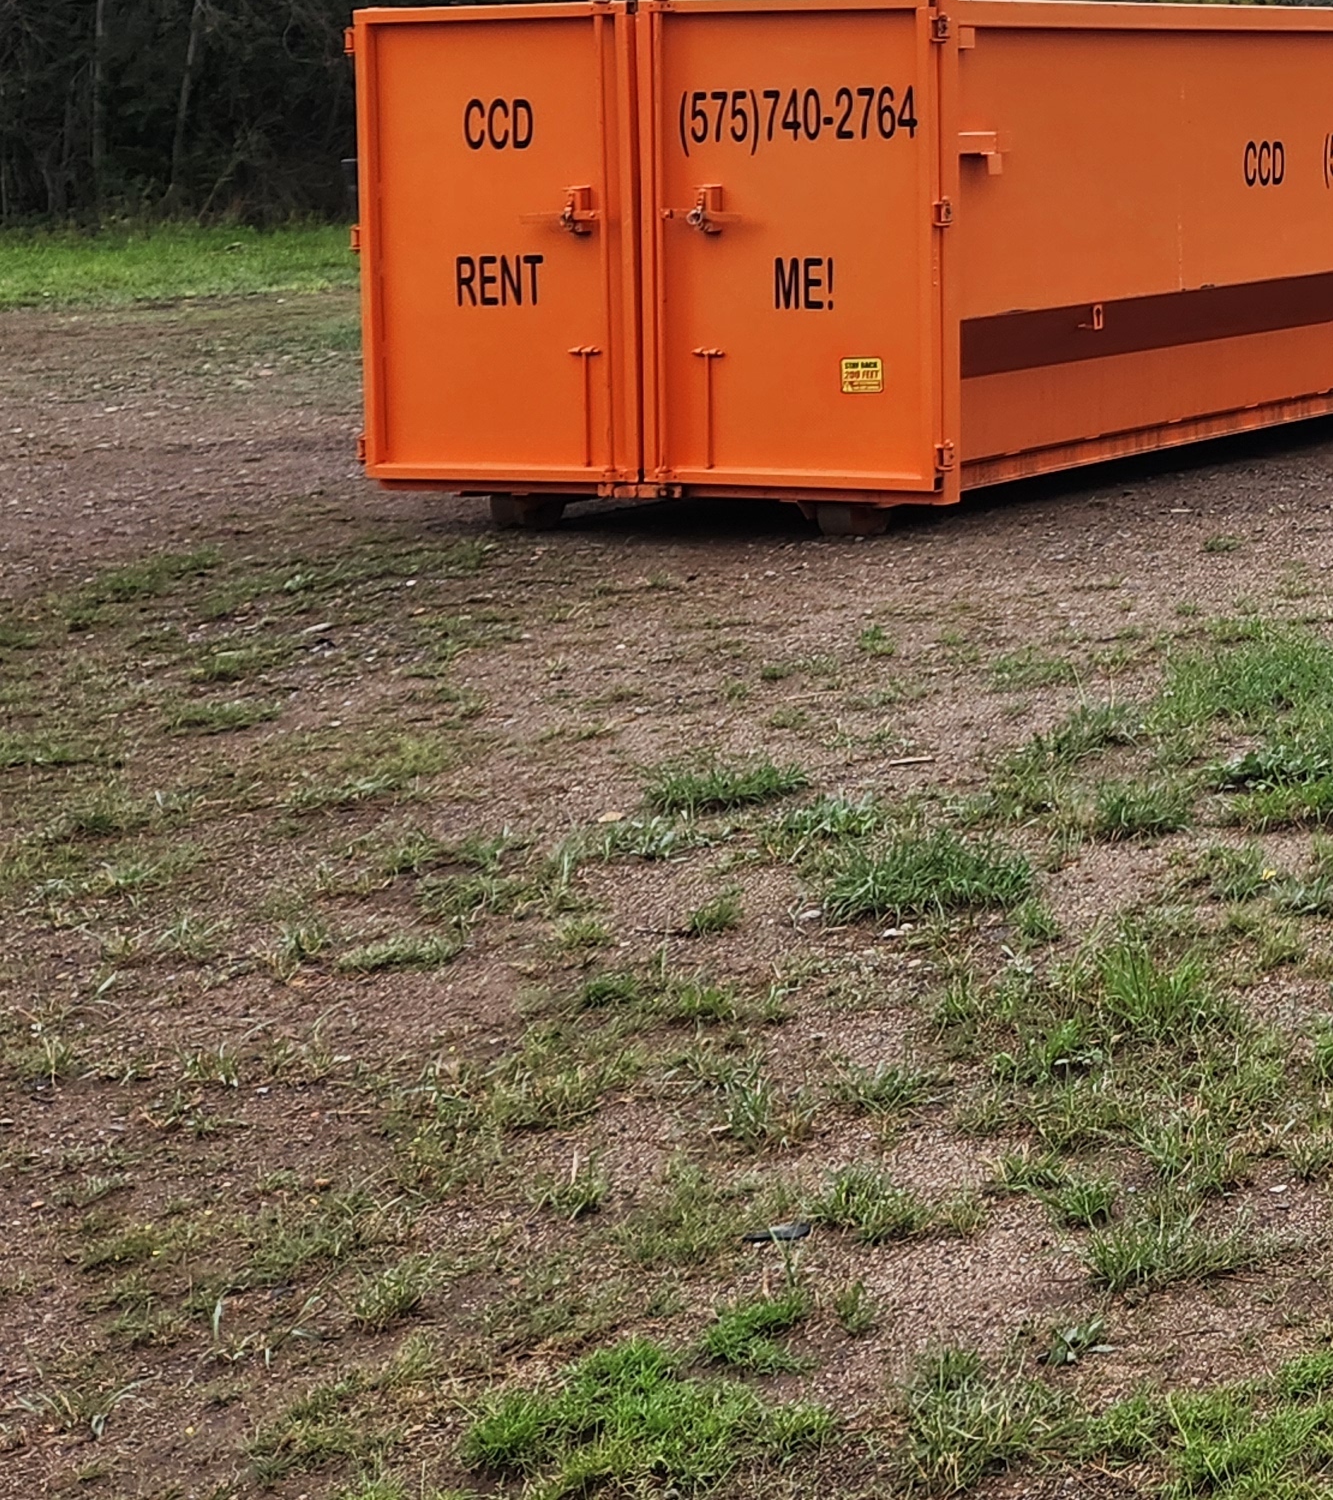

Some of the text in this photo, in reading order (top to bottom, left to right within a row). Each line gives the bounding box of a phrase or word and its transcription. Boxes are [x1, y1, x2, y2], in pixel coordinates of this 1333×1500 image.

[464, 85, 918, 156] CCD (575)740-2764
[1244, 140, 1285, 187] CCD
[455, 254, 834, 311] RENT ME!
